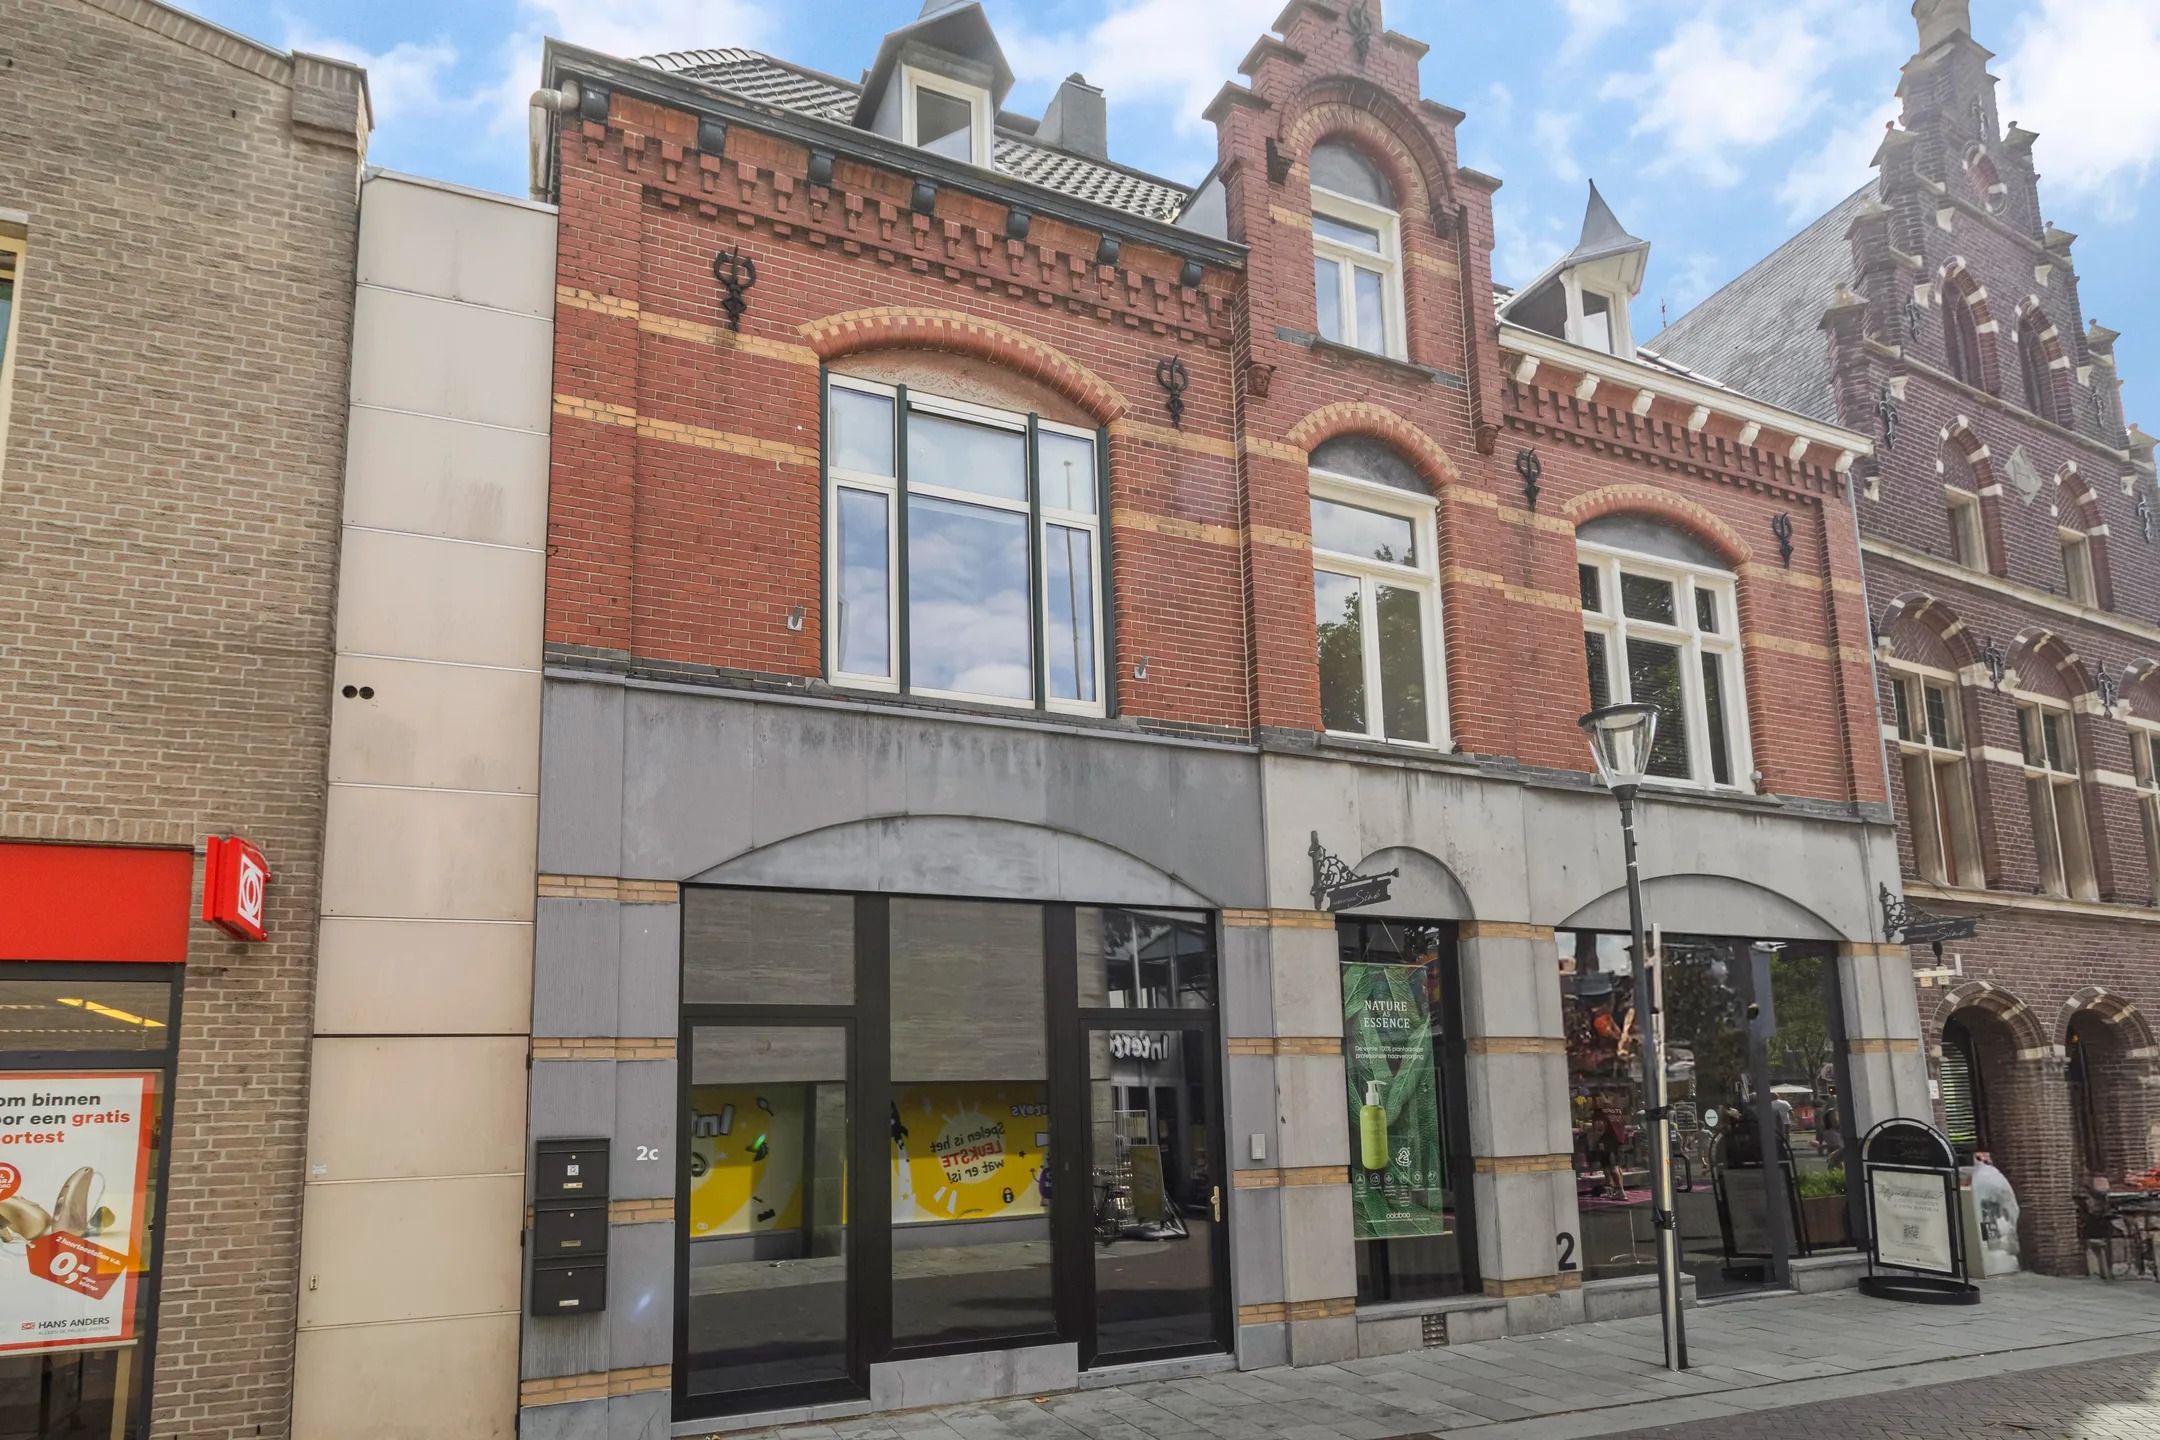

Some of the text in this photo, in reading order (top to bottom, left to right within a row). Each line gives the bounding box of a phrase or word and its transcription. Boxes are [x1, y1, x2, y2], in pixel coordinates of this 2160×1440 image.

[1364, 1000, 1408, 1012] NATURE
[1363, 1017, 1411, 1029] ESSENCE
[32, 1093, 101, 1106] binnen
[30, 1114, 67, 1125] een
[72, 1110, 130, 1127] gratis
[0, 1130, 65, 1145] ortest
[636, 1146, 659, 1160] 2c
[61, 1238, 110, 1261] hoortoestellen
[1556, 1232, 1577, 1271] 2
[38, 1316, 111, 1329] HANS ANDERS
